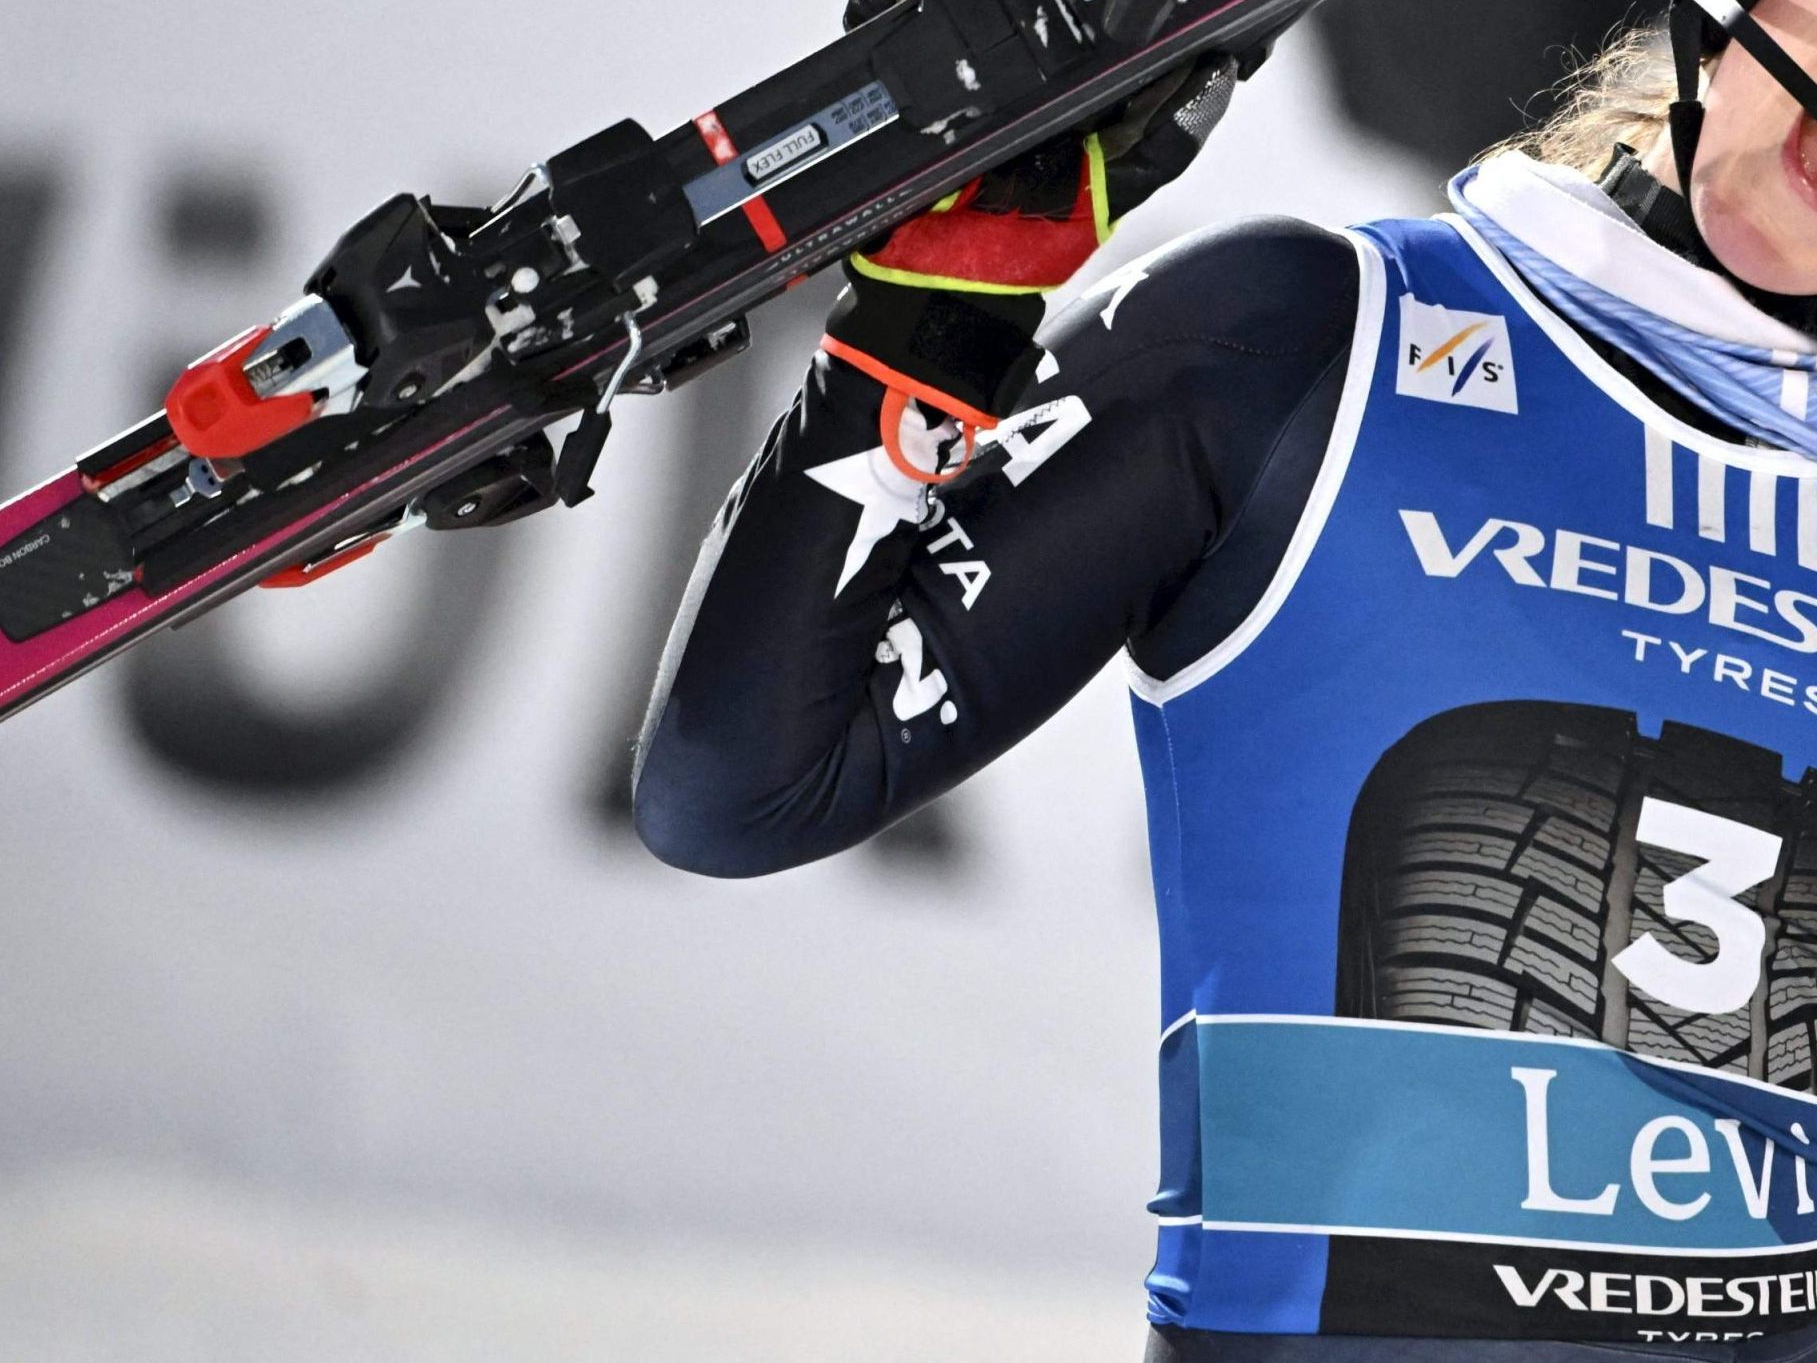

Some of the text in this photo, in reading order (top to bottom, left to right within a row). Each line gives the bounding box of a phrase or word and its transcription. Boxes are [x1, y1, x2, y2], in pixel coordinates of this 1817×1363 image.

[752, 130, 816, 174] FULL FLEX
[780, 196, 896, 264] ULTRAWALL
[12, 534, 50, 561] CARBON
[1610, 795, 1783, 1015] 3
[1510, 1065, 1816, 1221] Levi
